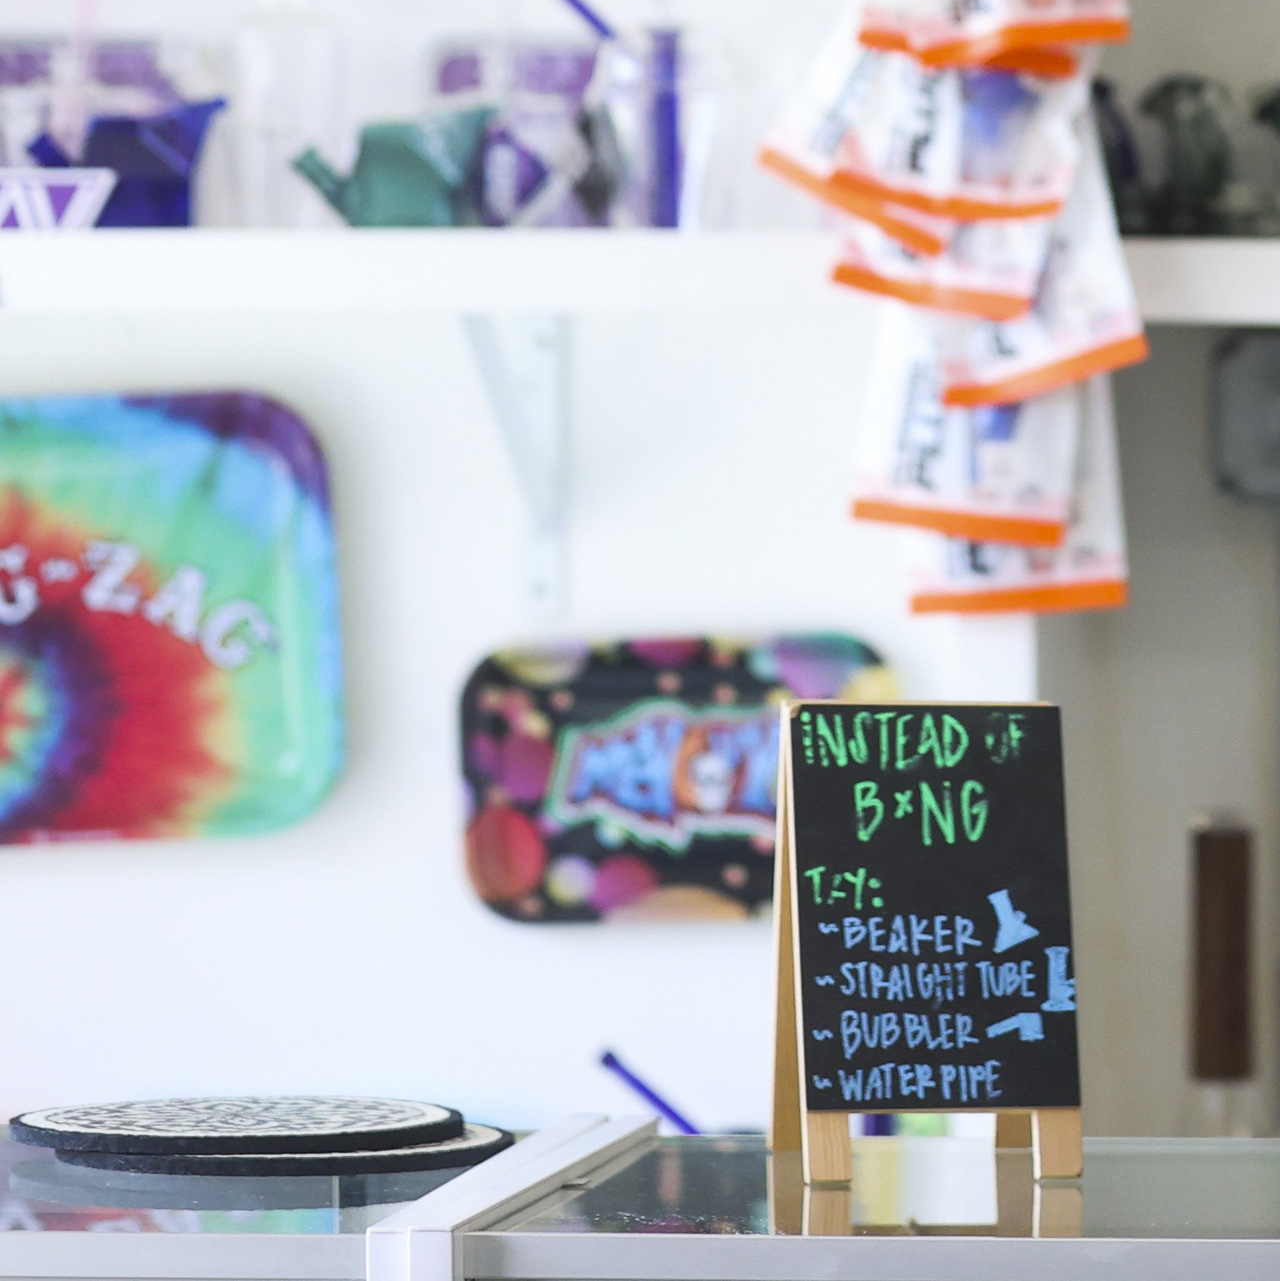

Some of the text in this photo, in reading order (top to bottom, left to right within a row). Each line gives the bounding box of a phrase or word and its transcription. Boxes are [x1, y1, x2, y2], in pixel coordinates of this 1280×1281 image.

[800, 711, 969, 770] INSTEAD
[842, 914, 983, 956] BEAKER
[840, 960, 1036, 1001] STRAIGHT TUBE
[840, 1009, 980, 1059] BUBBLER
